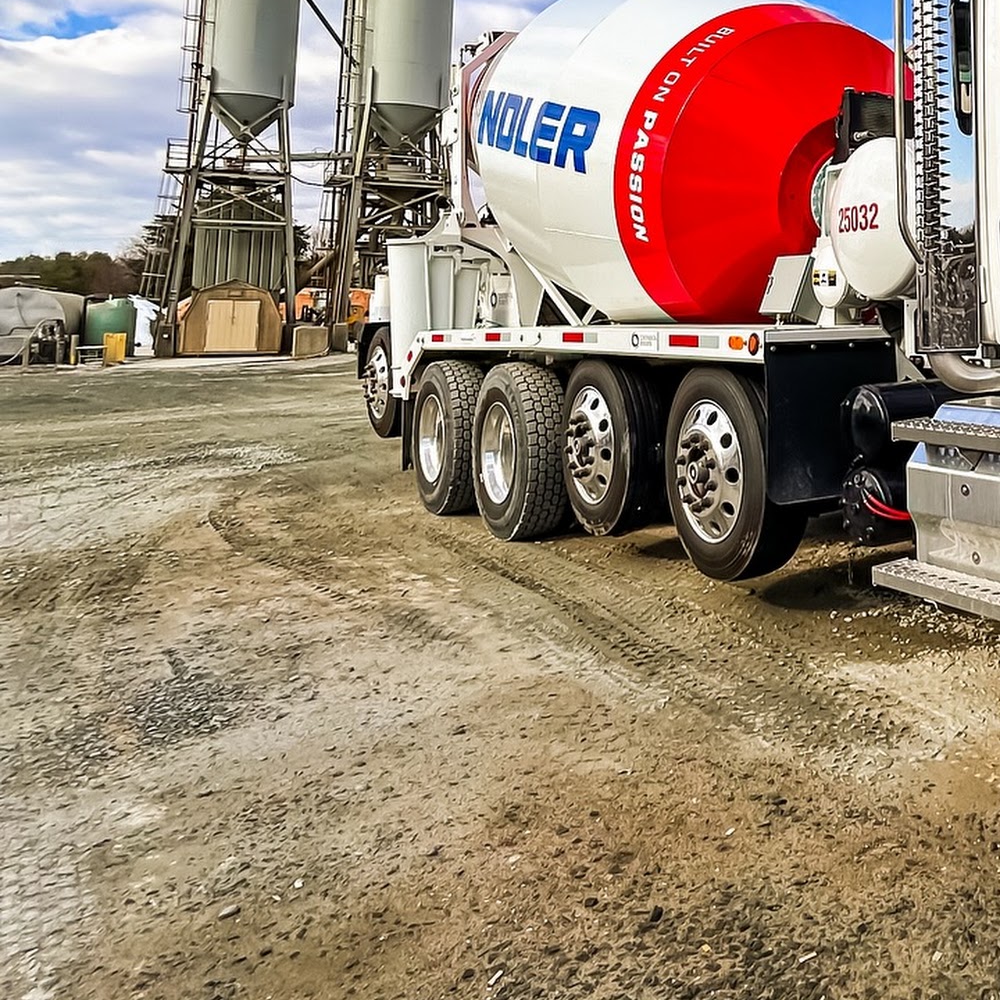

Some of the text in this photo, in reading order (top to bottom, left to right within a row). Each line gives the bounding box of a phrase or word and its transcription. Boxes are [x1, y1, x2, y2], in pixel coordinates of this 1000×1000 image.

[477, 90, 601, 174] NDLER
[629, 26, 735, 242] BUILT ON PASSION
[838, 202, 879, 233] 25032
